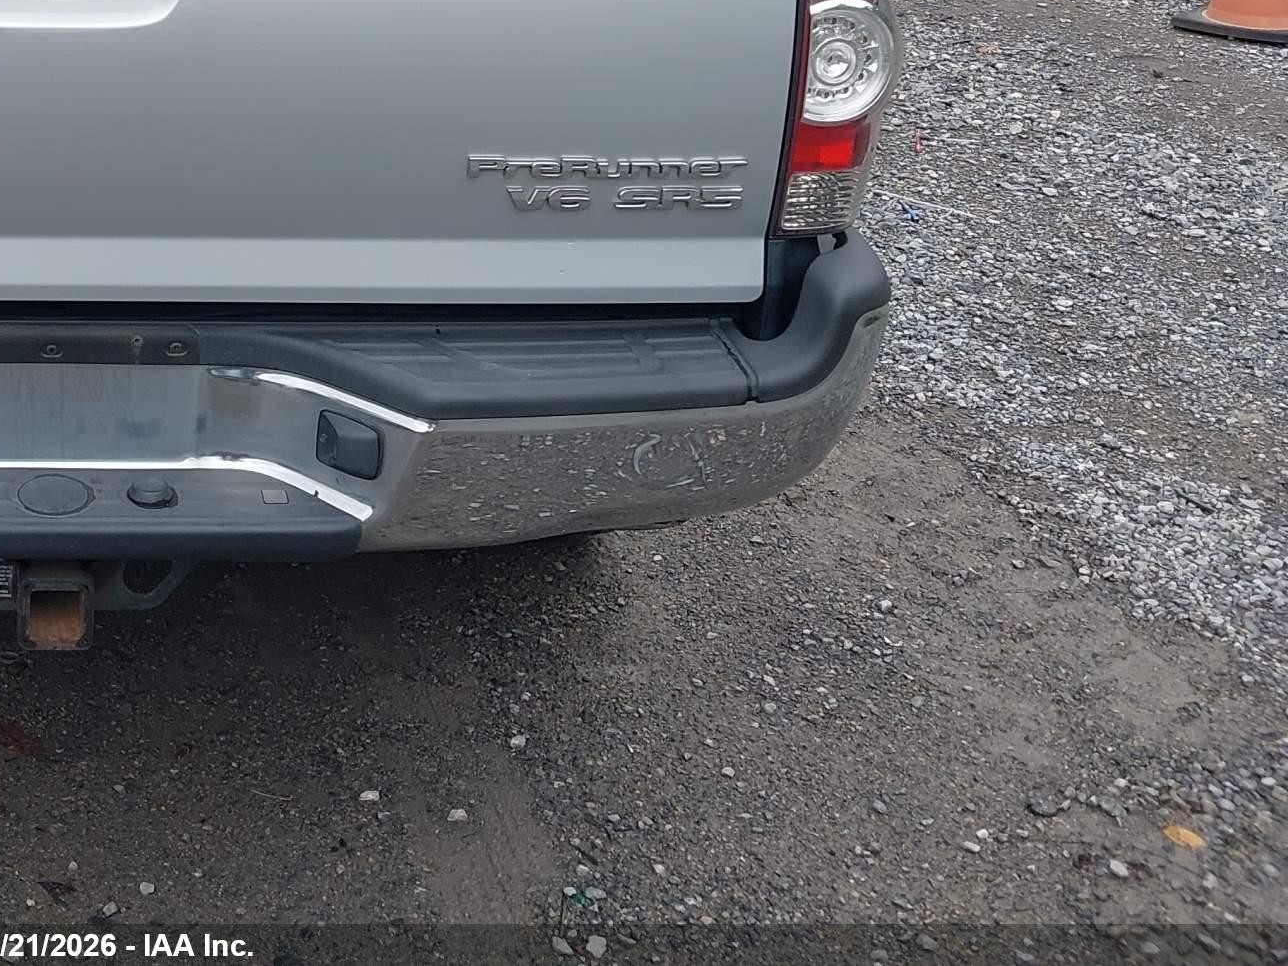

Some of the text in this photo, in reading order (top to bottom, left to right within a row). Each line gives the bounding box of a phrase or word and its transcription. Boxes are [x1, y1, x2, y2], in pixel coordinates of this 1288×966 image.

[466, 153, 748, 179] PreRunner
[506, 185, 744, 211] V6 SR5
